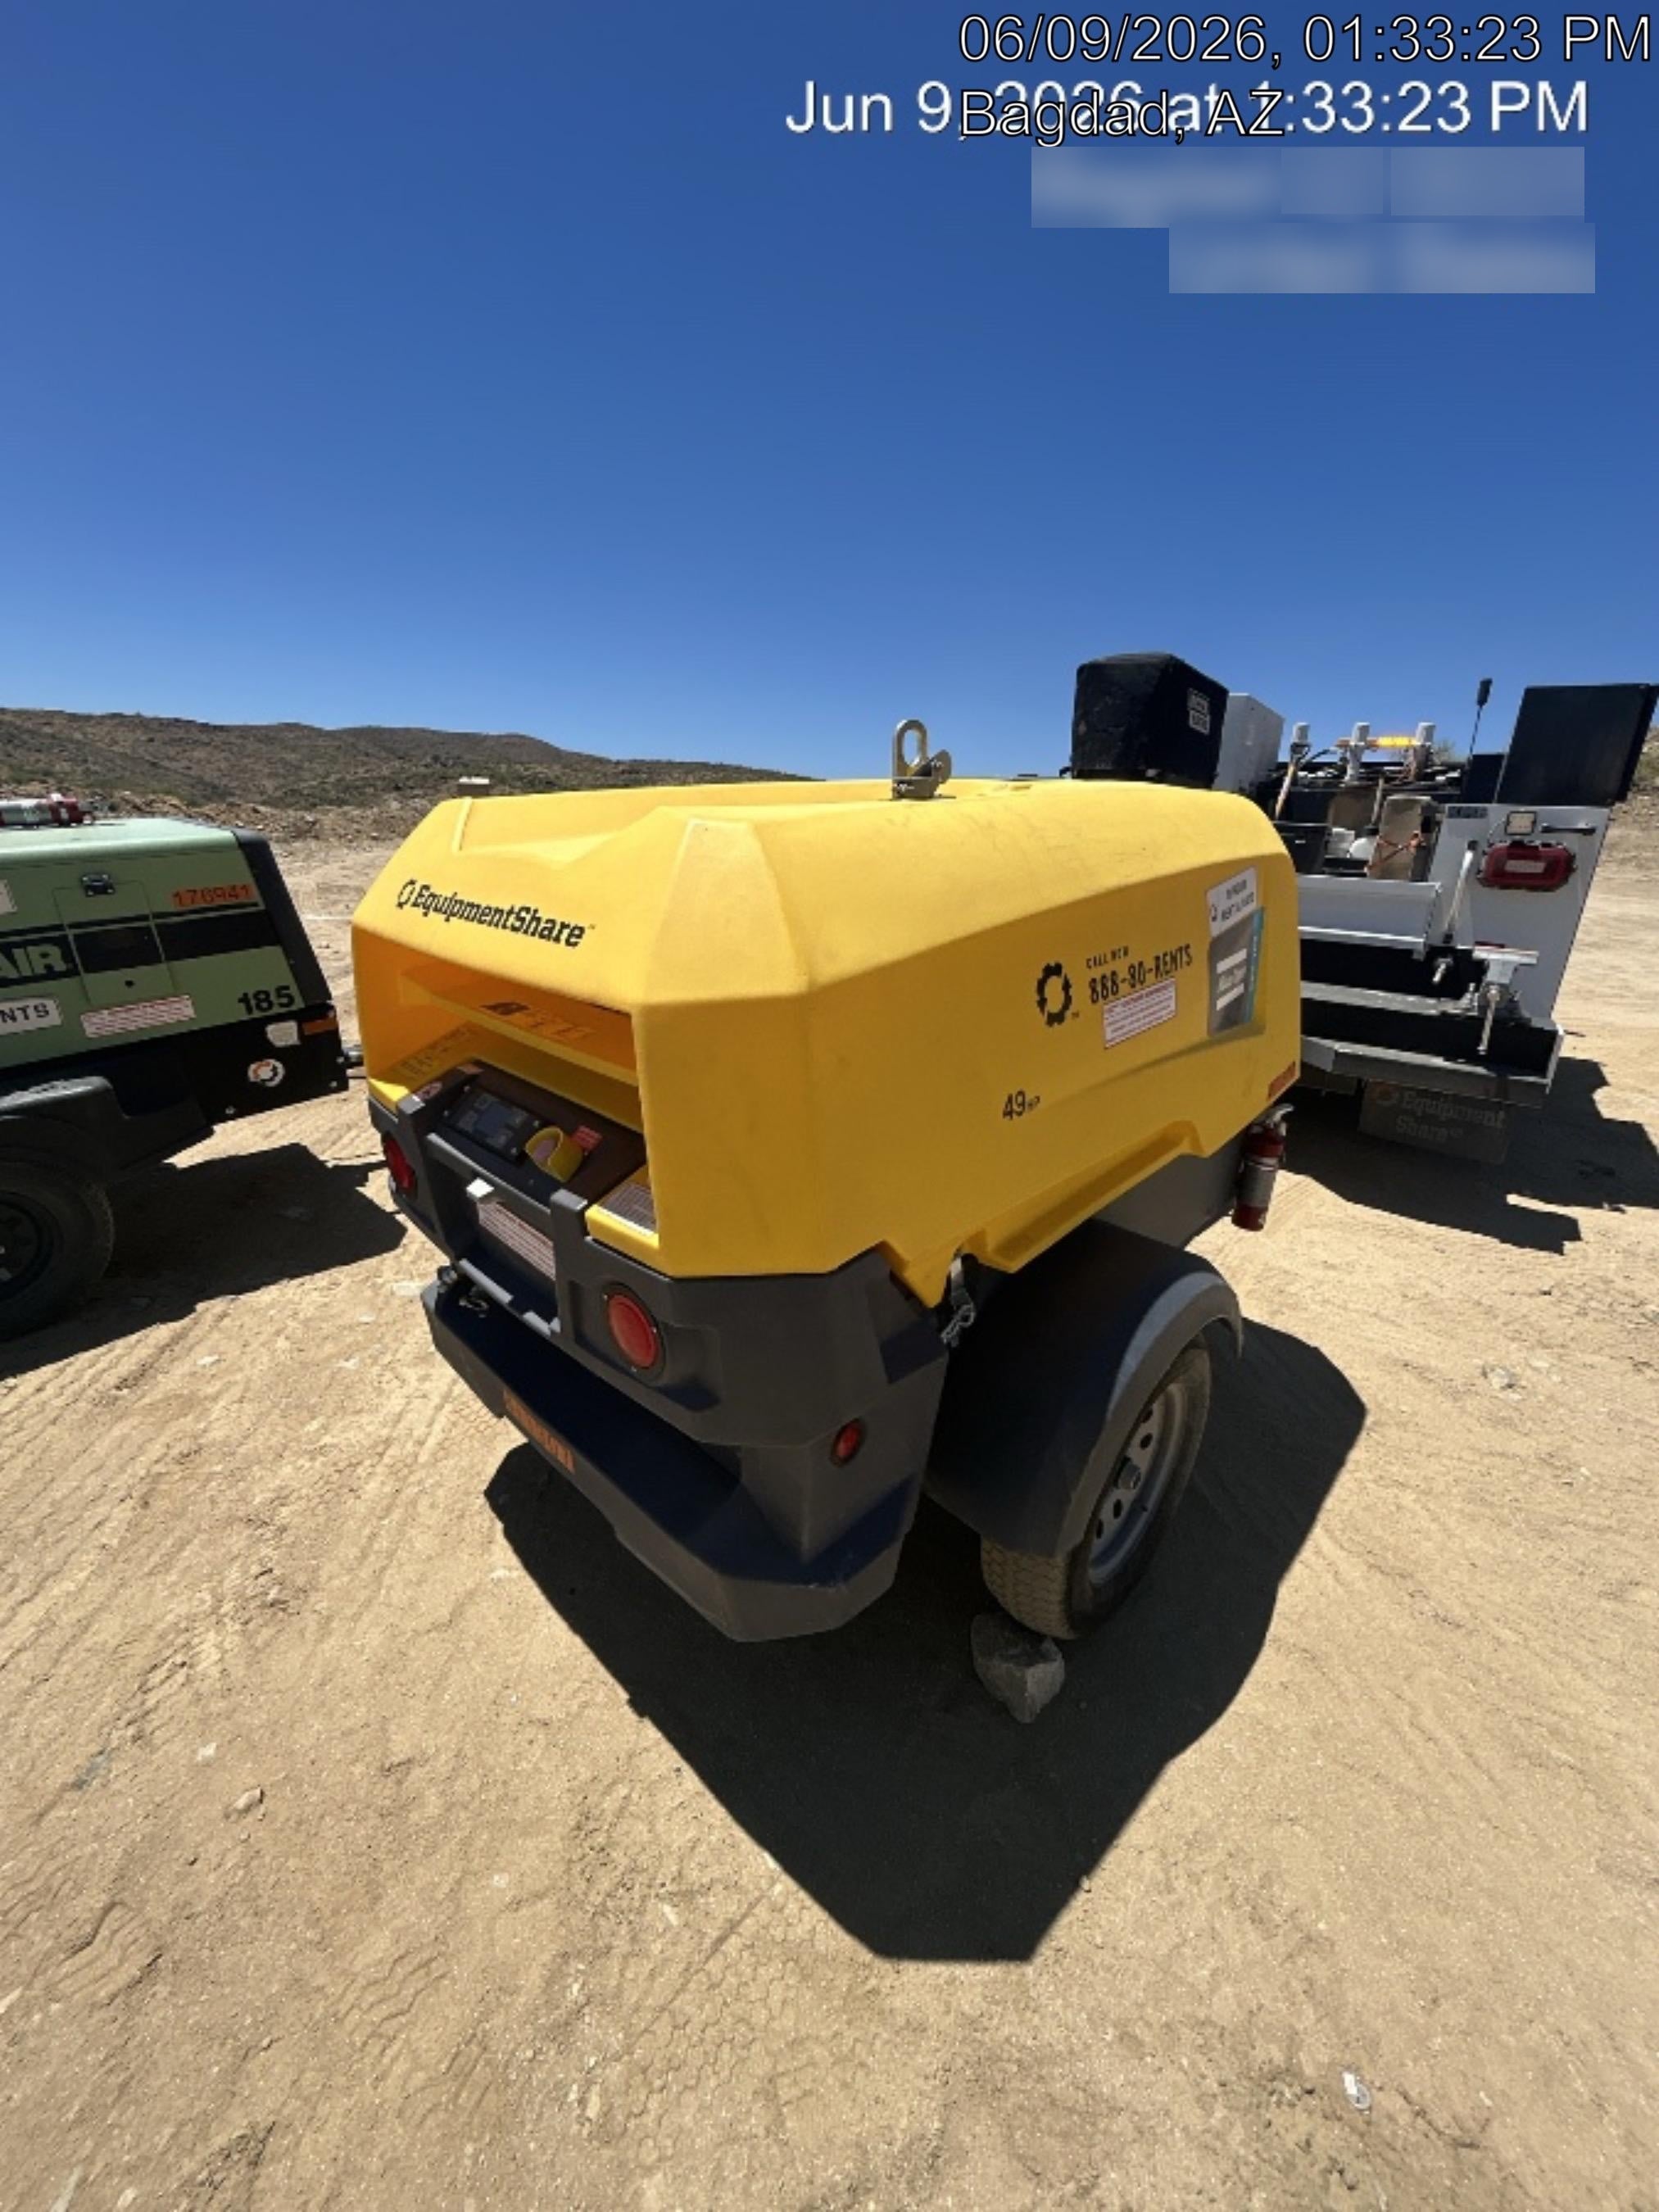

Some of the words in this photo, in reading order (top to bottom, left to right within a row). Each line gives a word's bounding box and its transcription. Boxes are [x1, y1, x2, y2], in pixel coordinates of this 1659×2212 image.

[411, 884, 586, 948] EquipmentShare
[238, 985, 295, 1015] 185
[1003, 1090, 1026, 1121] 49
